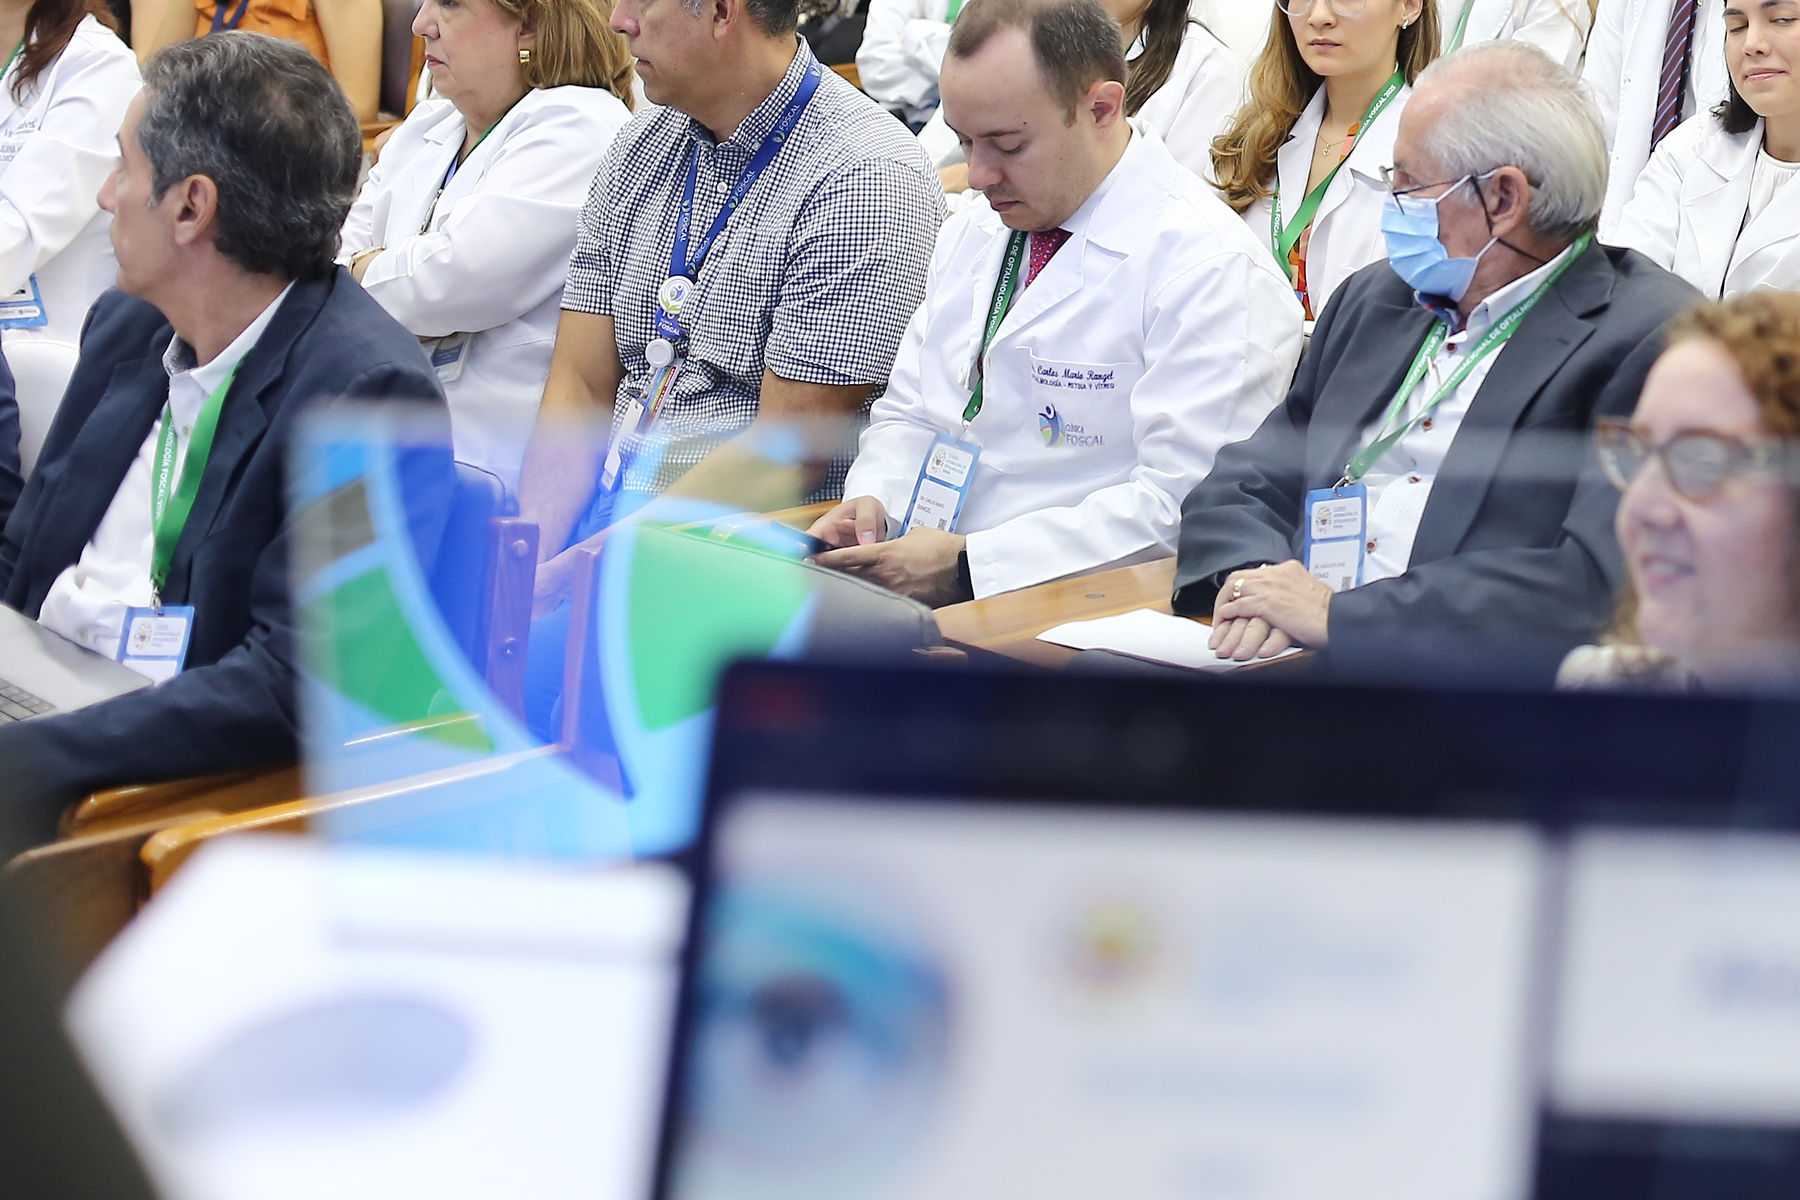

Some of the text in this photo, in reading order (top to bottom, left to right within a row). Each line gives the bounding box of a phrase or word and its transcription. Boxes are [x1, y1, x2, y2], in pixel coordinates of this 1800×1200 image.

[779, 104, 801, 132] FOSCAL
[1367, 97, 1387, 119] FOSCAL
[734, 169, 756, 198] FOSCAL
[680, 212, 691, 242] FOSCAL
[692, 235, 711, 263] FOSCAL
[1010, 245, 1020, 256] DE
[992, 257, 1016, 316] OFTALMOLOGÍA
[658, 321, 681, 336] FOSCAL
[1488, 329, 1501, 343] DE
[1037, 365, 1059, 378] Carlos
[1061, 368, 1084, 380] Mario
[1087, 370, 1114, 383] Rangel
[1066, 434, 1106, 447] FOSCAL
